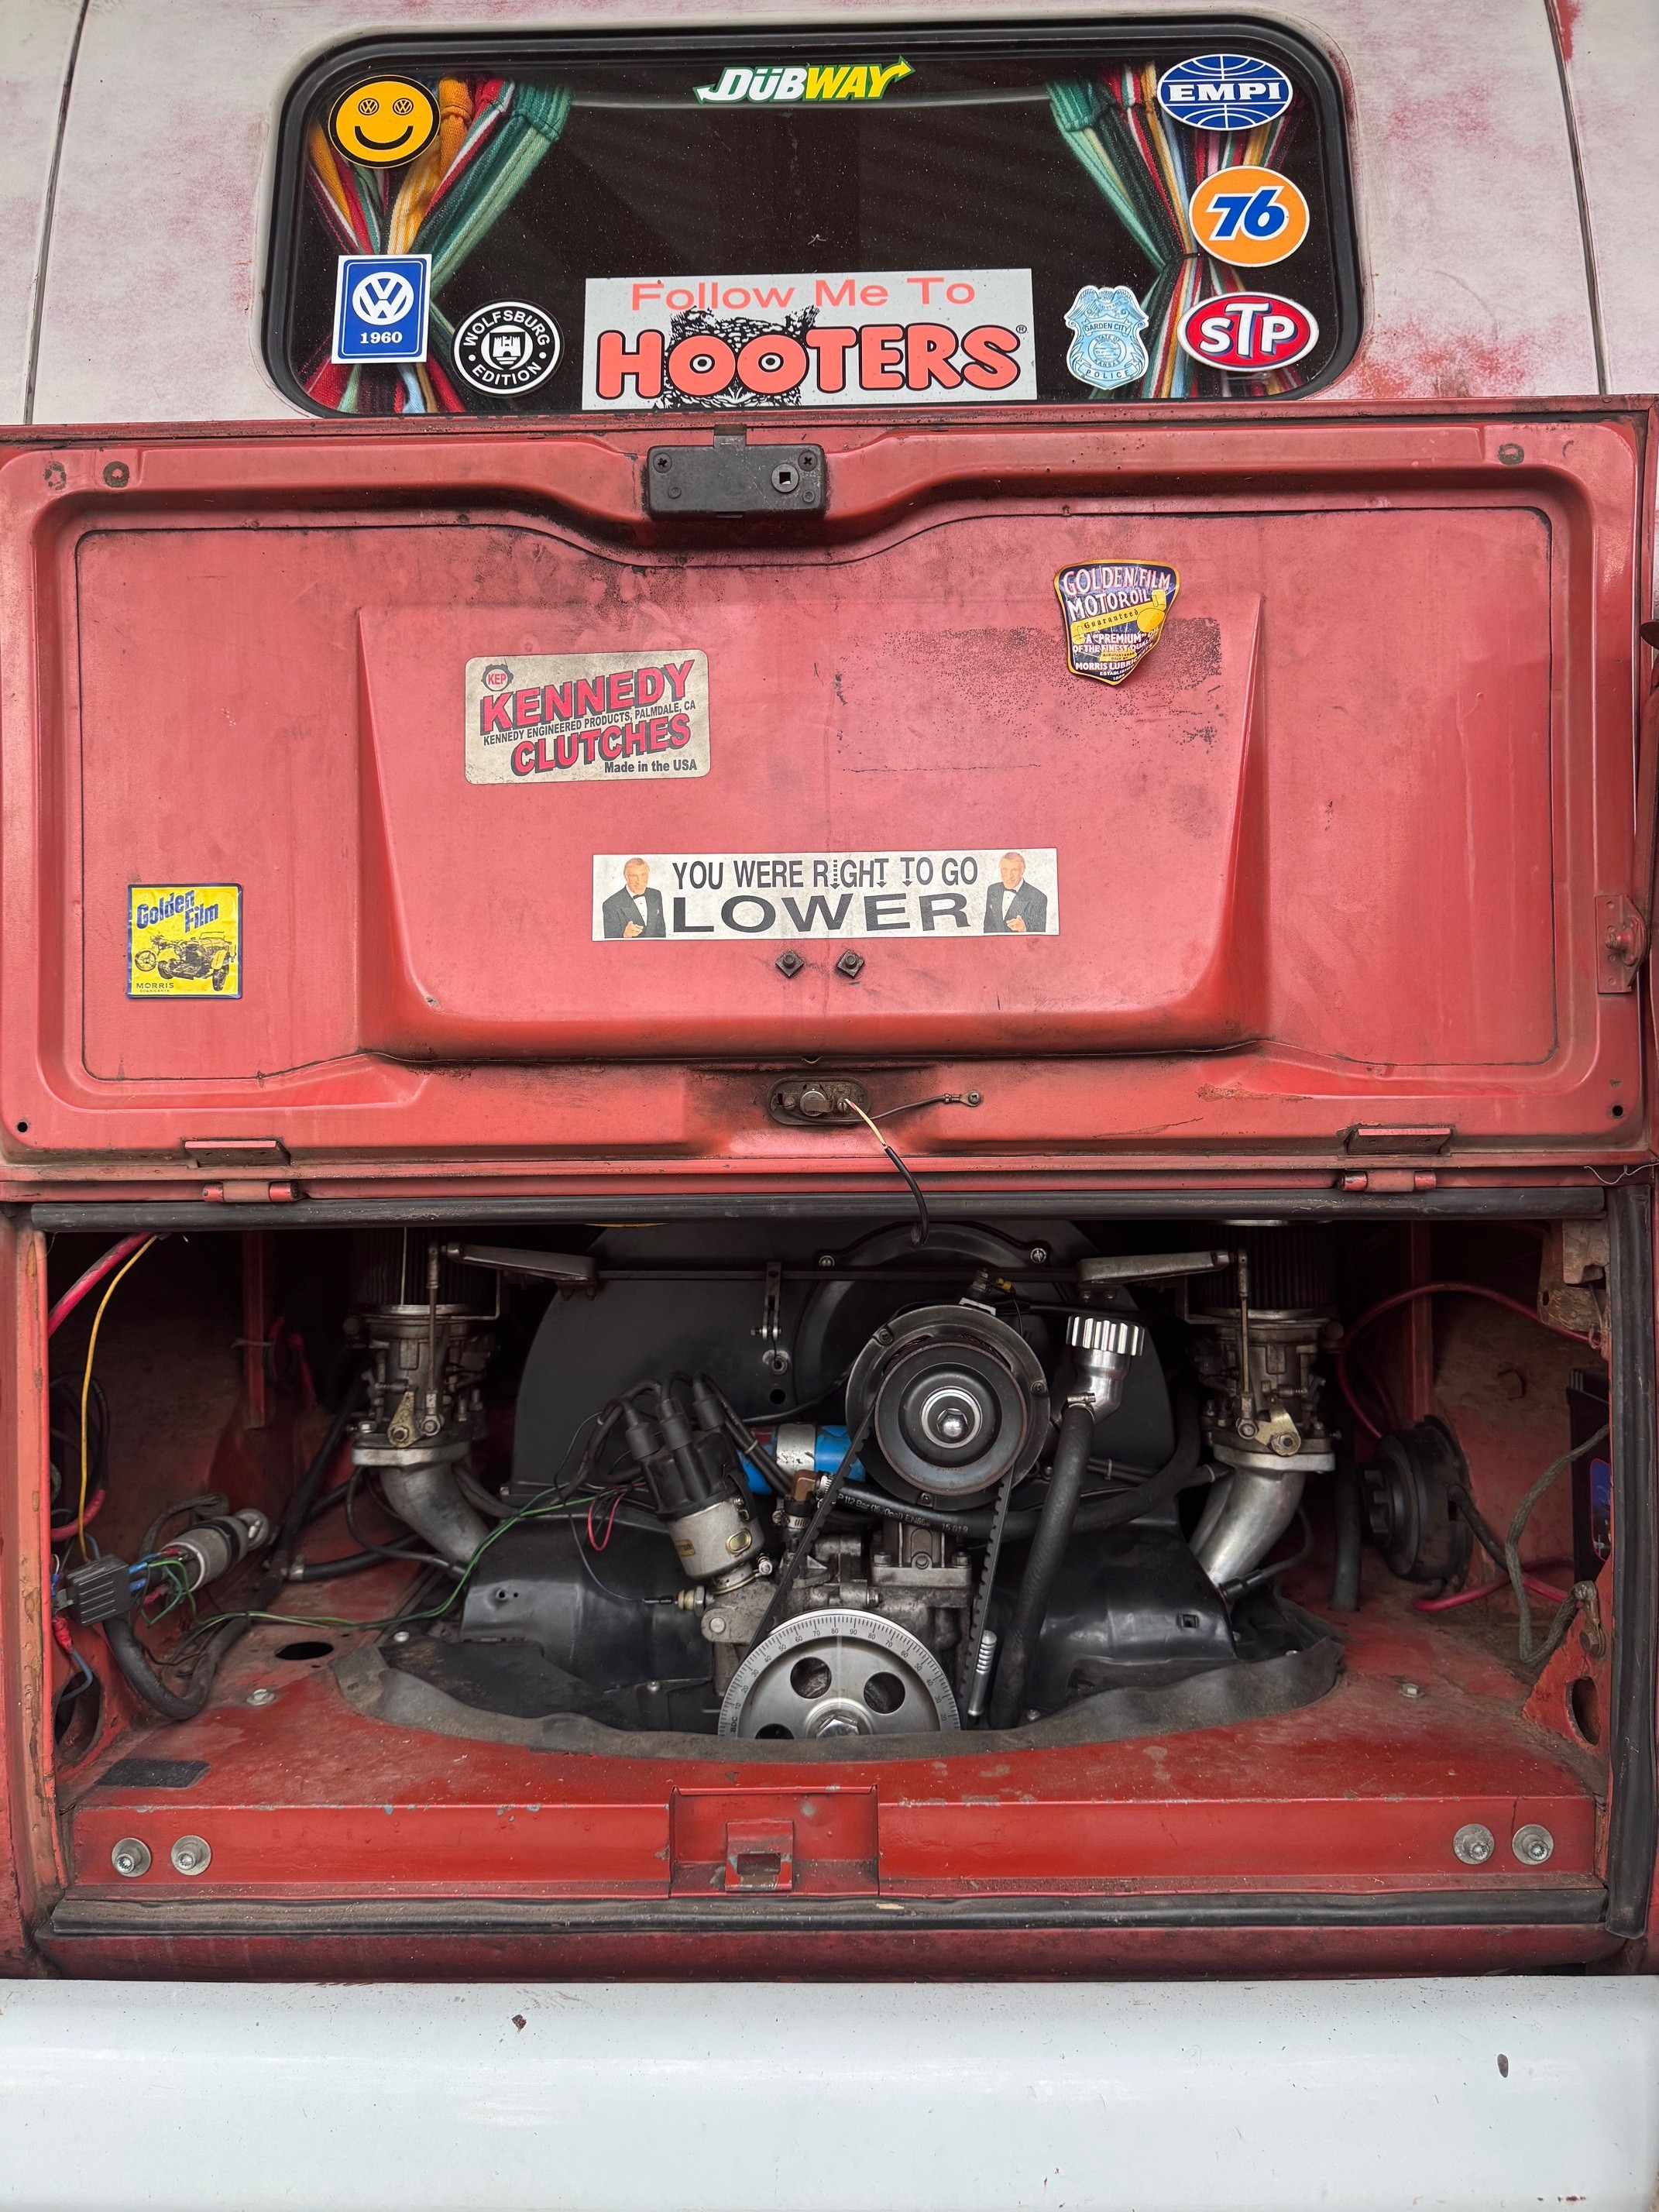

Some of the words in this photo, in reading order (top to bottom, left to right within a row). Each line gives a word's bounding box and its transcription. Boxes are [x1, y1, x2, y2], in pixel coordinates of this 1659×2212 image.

[1169, 84, 1281, 101] EMPI
[1206, 185, 1289, 242] 76
[631, 281, 795, 311] Follow
[815, 278, 888, 307] Me
[907, 276, 975, 305] To
[360, 331, 403, 344] 1960
[463, 310, 550, 346] WOLFSBURG
[1084, 323, 1112, 331] GARDEN
[1114, 323, 1129, 332] CITY
[1199, 302, 1297, 359] STP
[472, 362, 541, 386] EDITION
[1086, 369, 1130, 379] POLICE
[1094, 359, 1120, 367] KANSAS
[1062, 566, 1136, 596] GOLDEN
[1139, 568, 1171, 591] FILM
[1084, 609, 1139, 629] Guaranteed
[488, 672, 507, 685] KEP
[1076, 662, 1108, 671] MORRIS
[480, 659, 695, 736] KENNEDY
[484, 730, 524, 746] KENNEDY
[527, 720, 582, 739] ENGINEERED
[584, 712, 632, 729] PRODUCTS,
[634, 702, 682, 720] PALMDALE,
[684, 699, 696, 711] CA
[510, 713, 692, 776] CLUTCHES
[604, 762, 634, 773] Made
[638, 761, 648, 772] in
[651, 761, 670, 772] the
[673, 759, 697, 771] USA
[672, 860, 724, 890] YOU
[733, 859, 809, 889] WERE
[813, 857, 889, 891] RIGHT
[900, 857, 933, 888] TO
[942, 857, 978, 887] GO
[136, 890, 194, 929] Golden
[185, 903, 218, 933] Film
[673, 893, 971, 933] LOWER
[741, 1685, 749, 1694] 20
[751, 1669, 759, 1678] 30
[901, 1650, 908, 1658] 60
[915, 1663, 922, 1671] 50
[926, 1678, 933, 1687] 40
[935, 1695, 941, 1703] 30
[940, 1713, 946, 1722] 20
